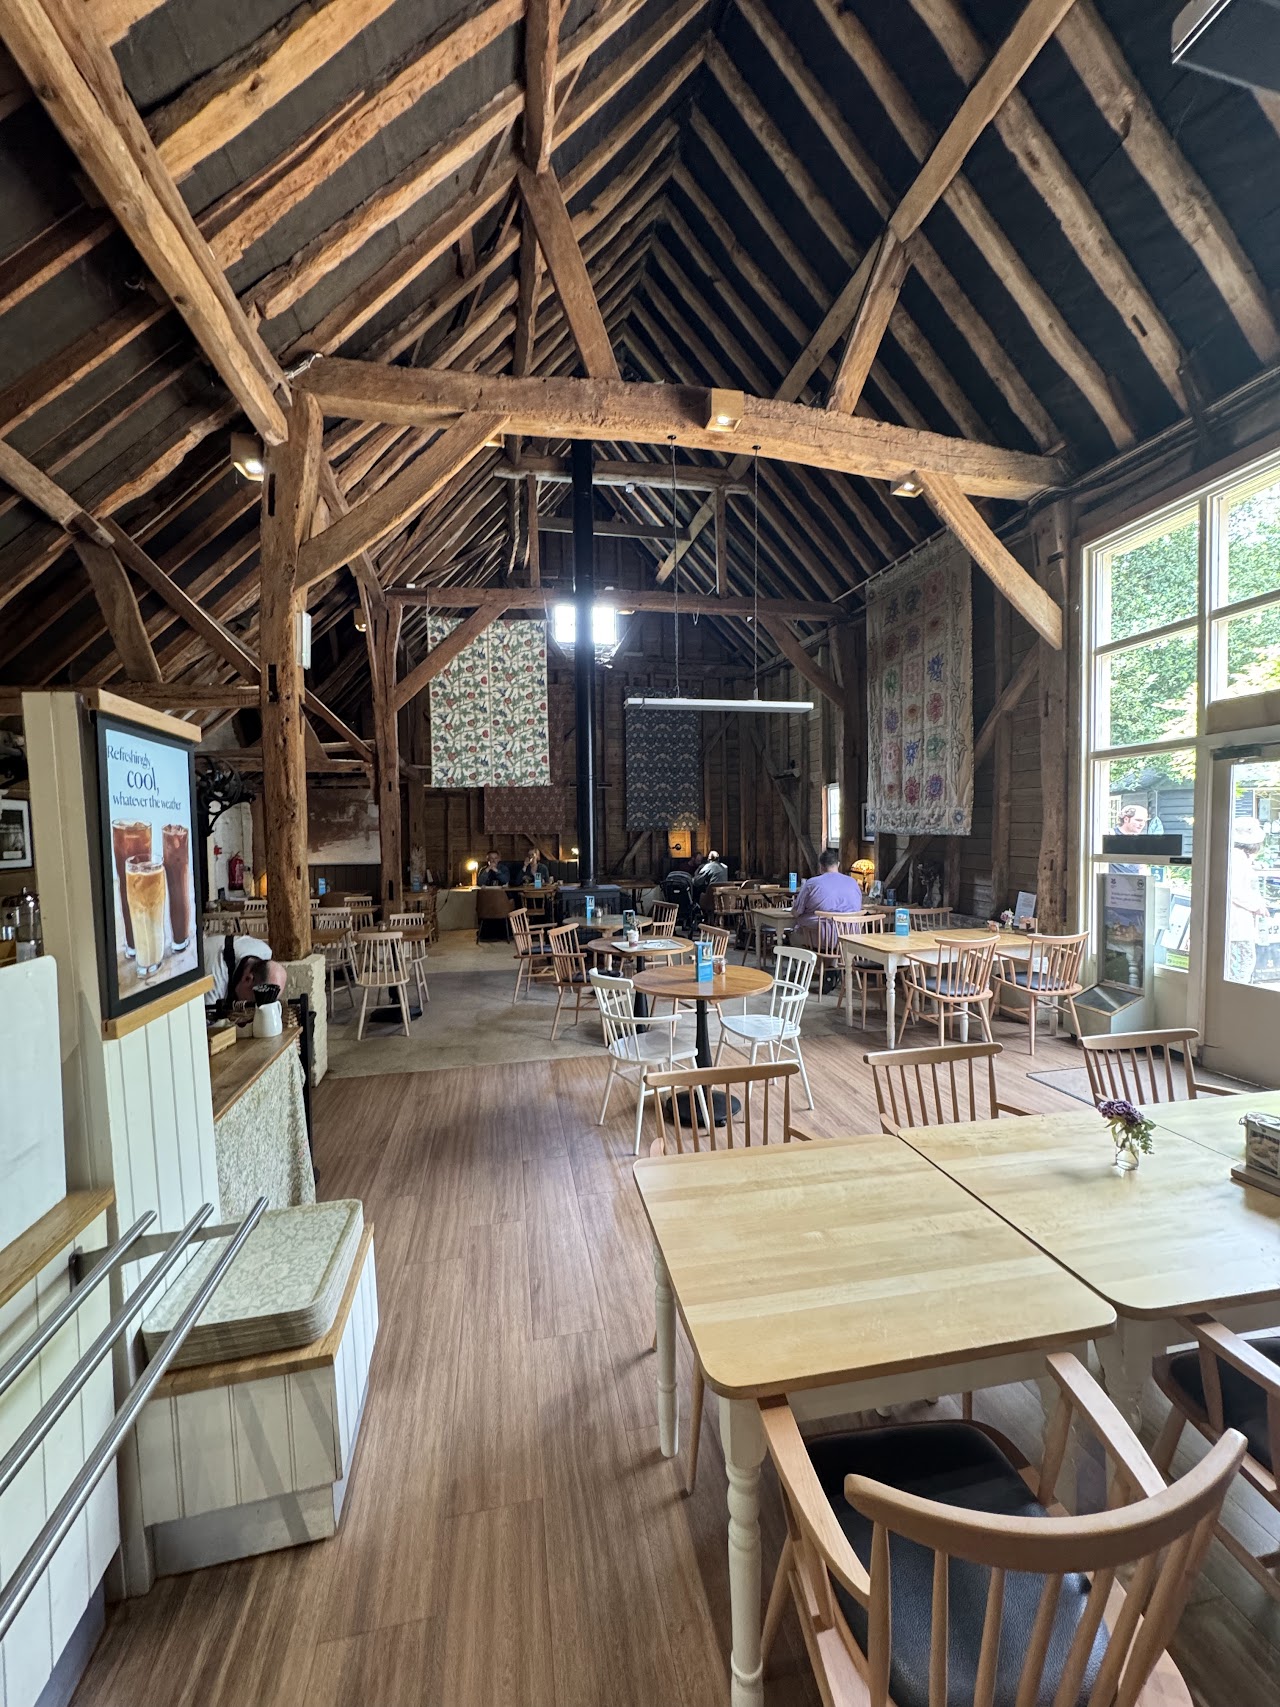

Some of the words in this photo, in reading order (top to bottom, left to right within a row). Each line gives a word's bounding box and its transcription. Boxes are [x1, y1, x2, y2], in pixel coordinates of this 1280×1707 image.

[107, 745, 151, 770] Refreshingly
[127, 767, 159, 796] cool,
[113, 791, 148, 808] whatever
[149, 795, 160, 809] the
[161, 797, 181, 811] weather
